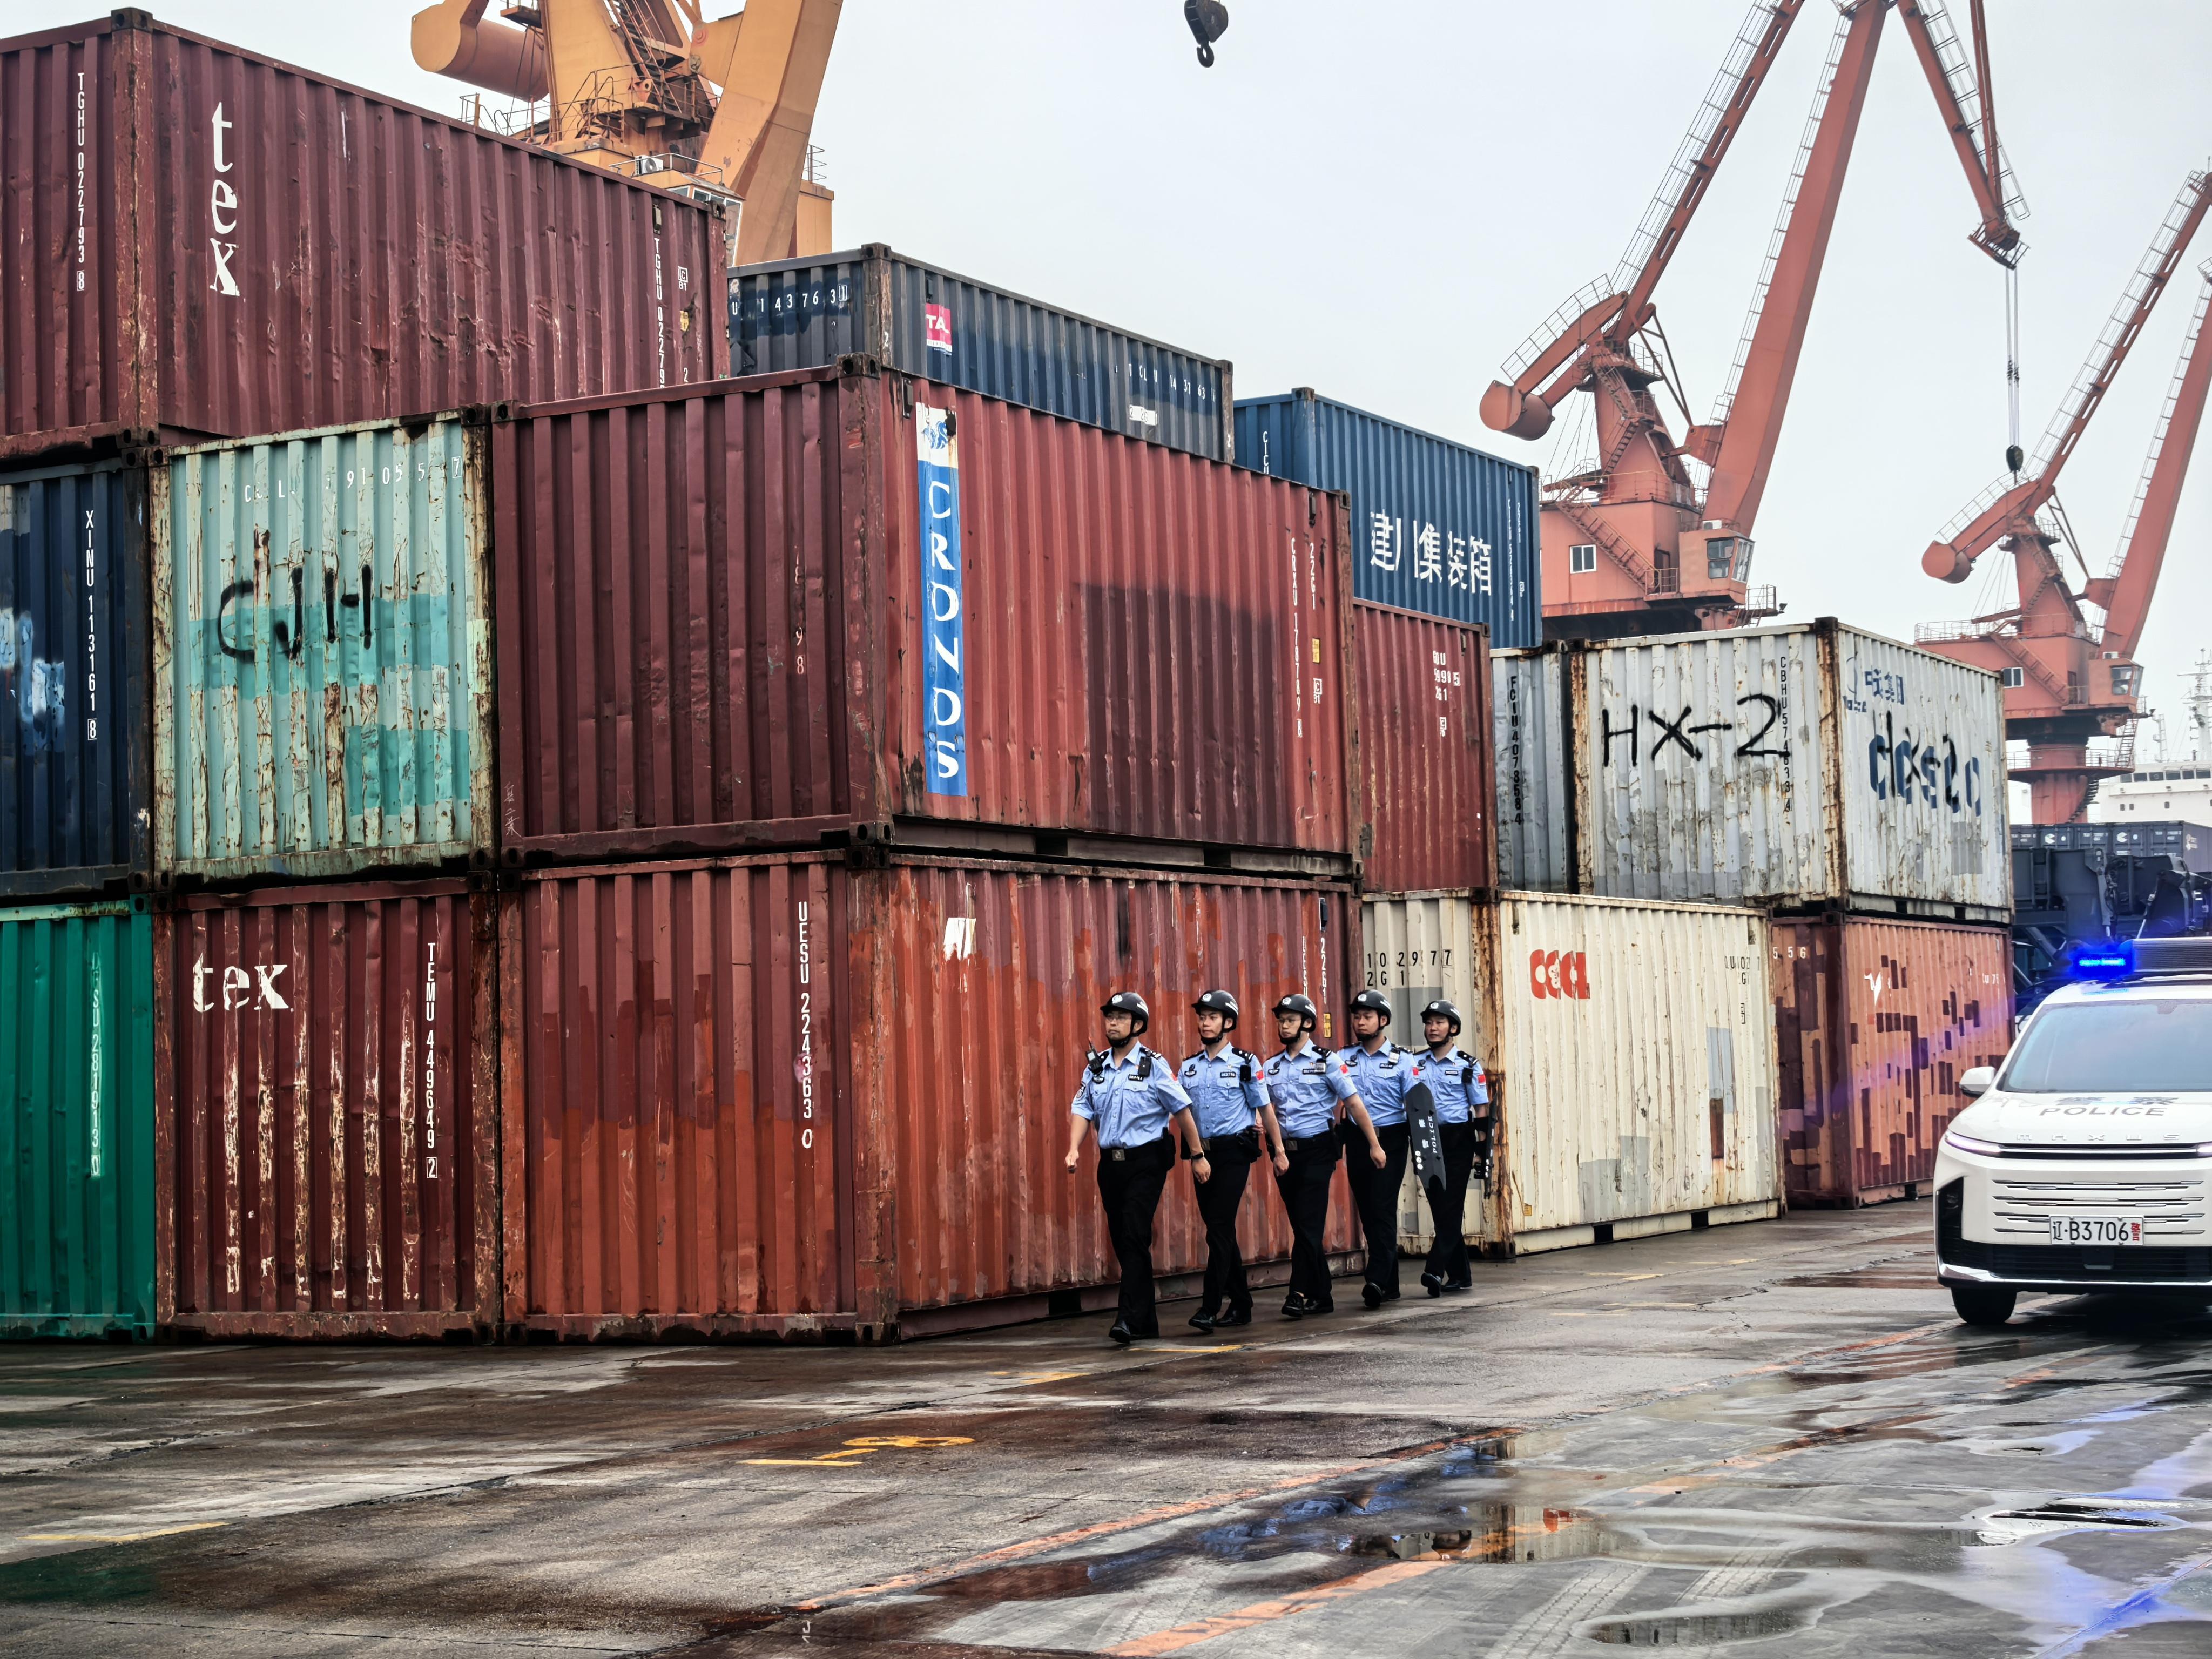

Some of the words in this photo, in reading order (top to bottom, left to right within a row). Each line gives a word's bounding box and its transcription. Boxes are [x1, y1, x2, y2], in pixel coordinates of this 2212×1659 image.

[210, 102, 240, 296] tex
[77, 271, 84, 291] 8
[654, 238, 663, 300] TGHU
[657, 306, 665, 388] 02279
[85, 510, 94, 587] XINU
[88, 595, 96, 712] 113161
[88, 719, 97, 740] 8
[1510, 676, 1519, 727] FCIU
[1512, 734, 1522, 811] 407858
[799, 901, 809, 983] UESU
[193, 952, 289, 1013] tex
[426, 942, 435, 1021] TEMU
[426, 1029, 435, 1149] 449649
[800, 992, 812, 1118] 224363
[1428, 1115, 1438, 1154] POLICE
[2039, 1107, 2168, 1116] POLICE
[427, 1157, 437, 1178] 2
